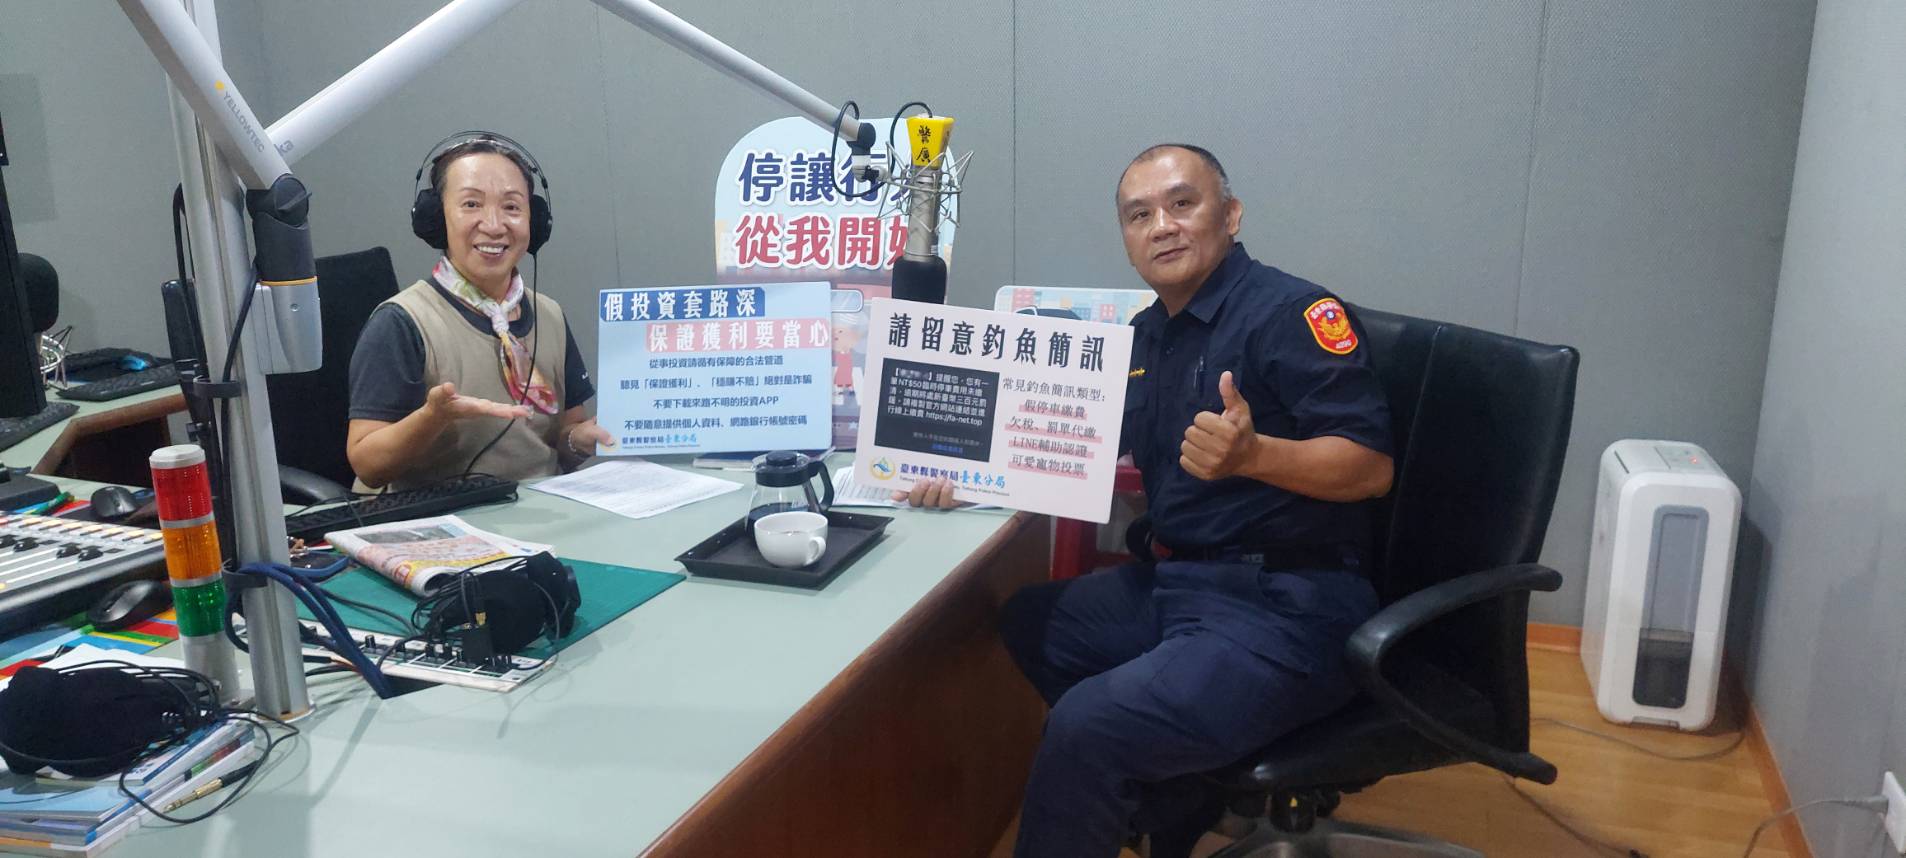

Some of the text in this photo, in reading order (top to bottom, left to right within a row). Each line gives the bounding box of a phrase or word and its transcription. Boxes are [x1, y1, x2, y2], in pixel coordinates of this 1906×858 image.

[223, 90, 264, 153] YELLOWTEC
[738, 152, 910, 202] 停讓行
[605, 289, 756, 321] 假投資套路深
[649, 319, 829, 352] 保證獲利要當心
[888, 312, 1105, 372] 請留意釣魚簡訊
[653, 396, 779, 409] 不要下載來路不明的投資APP
[1025, 399, 1086, 418] 假停車繳費
[1012, 436, 1088, 458] LINE輔助認證
[1011, 453, 1086, 476] 可愛寵物投票
